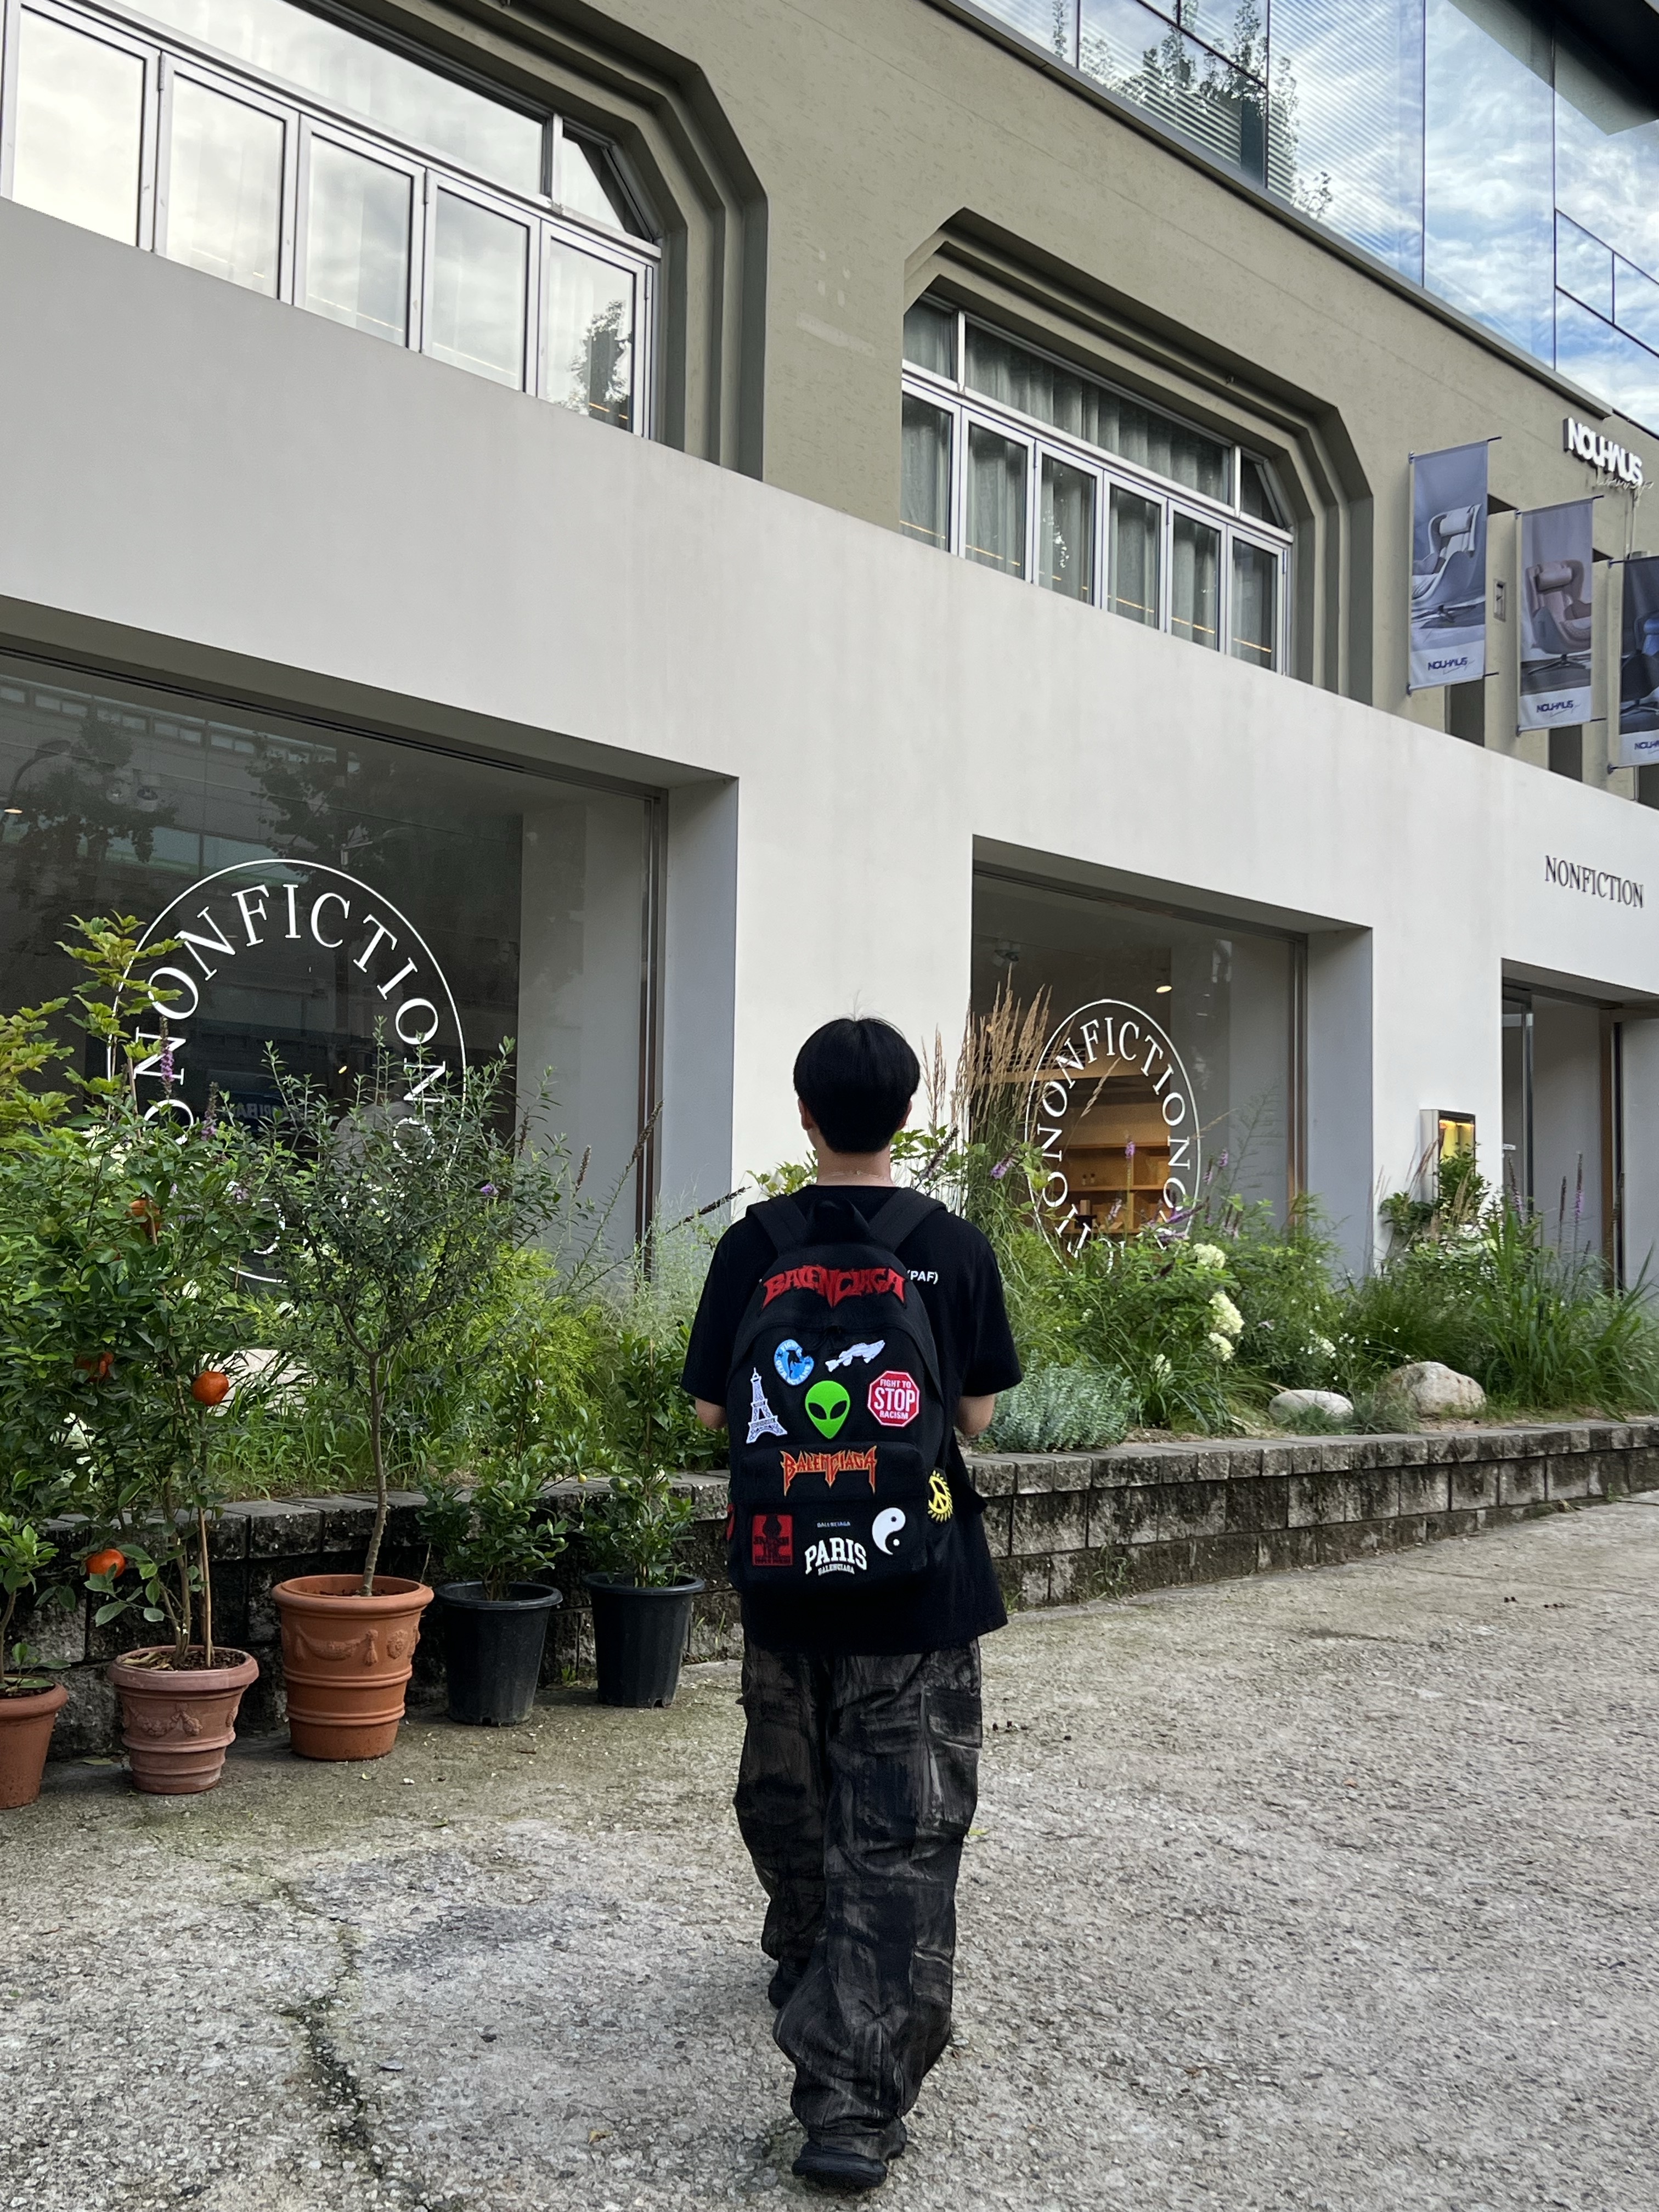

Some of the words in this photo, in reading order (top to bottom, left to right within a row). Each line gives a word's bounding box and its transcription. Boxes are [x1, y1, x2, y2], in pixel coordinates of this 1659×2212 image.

[1564, 417, 1643, 486] NOUHAUS
[1427, 657, 1468, 671] NOUHAUS
[1536, 700, 1574, 713] NOUHAUS
[1544, 855, 1644, 909] NONFICTION
[761, 1264, 906, 1310] BALENCIAGA
[873, 1386, 916, 1412] STOP
[880, 1378, 901, 1388] FIGHT
[901, 1380, 912, 1389] TO
[879, 1410, 909, 1420] RACISM
[779, 1445, 878, 1497] BALENCIAGA
[804, 1537, 867, 1575] PARIS
